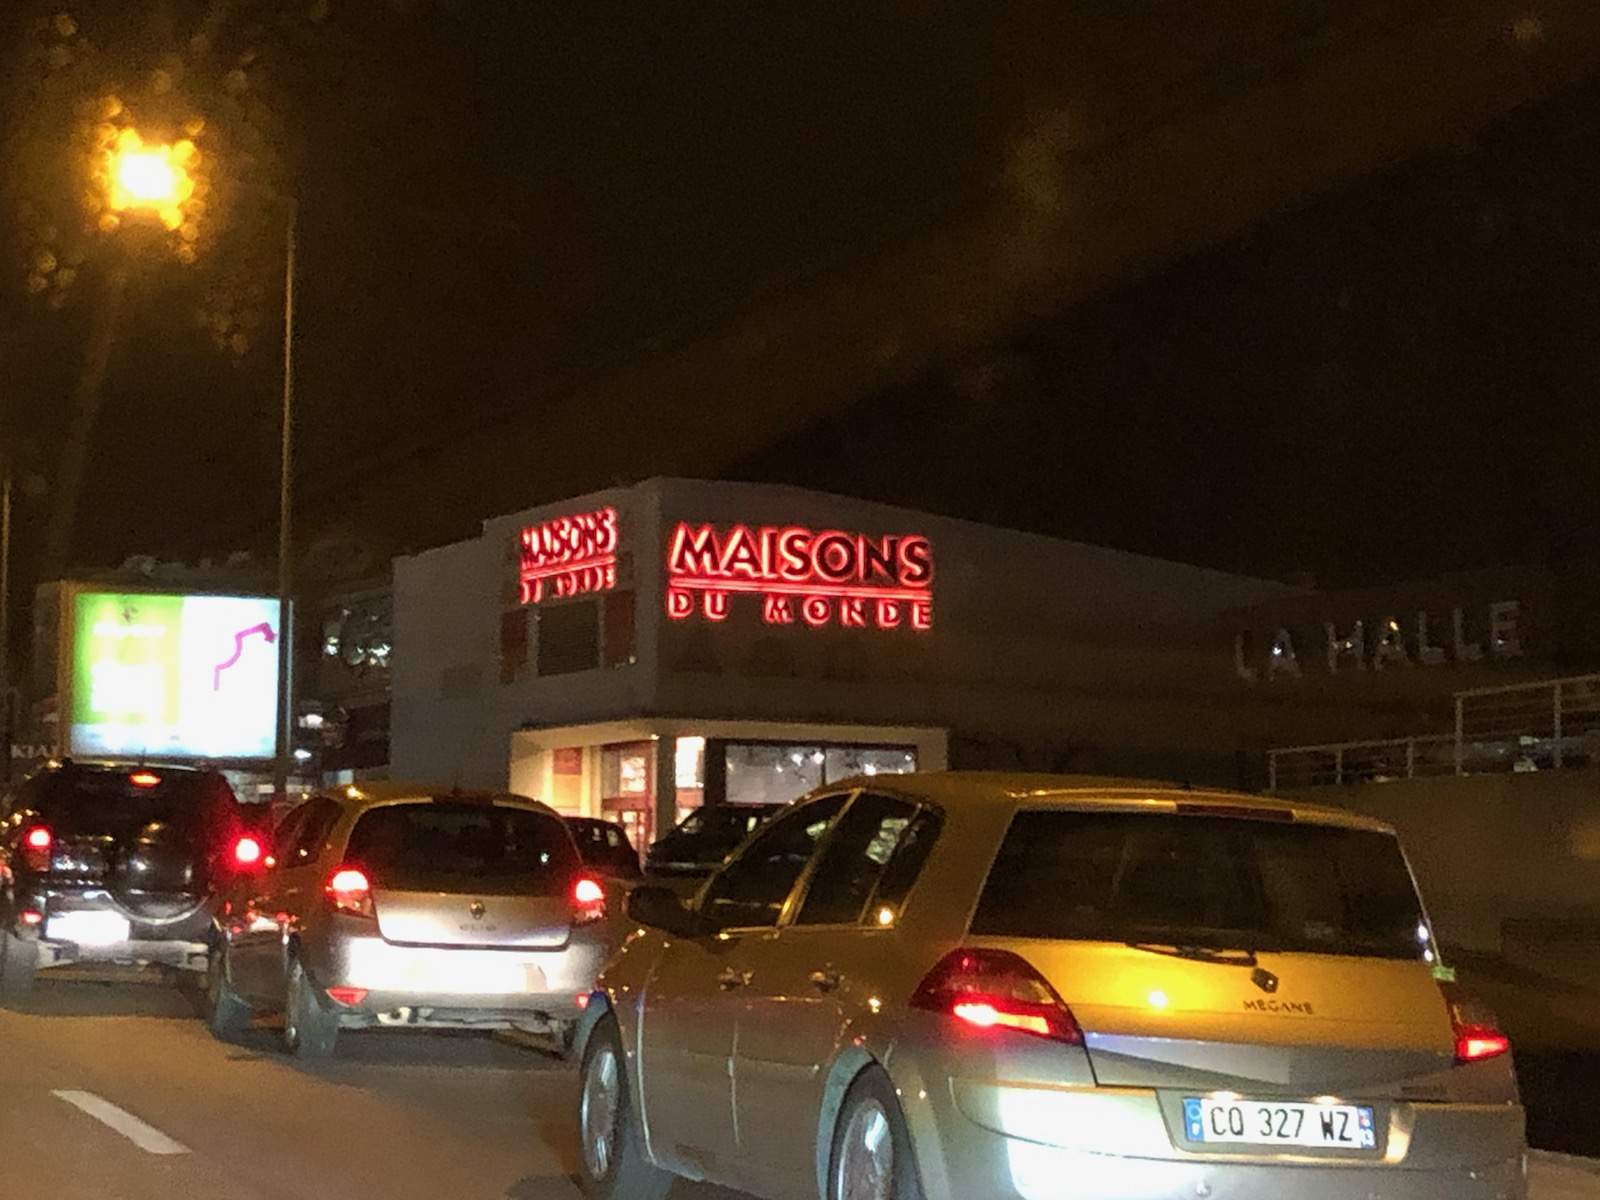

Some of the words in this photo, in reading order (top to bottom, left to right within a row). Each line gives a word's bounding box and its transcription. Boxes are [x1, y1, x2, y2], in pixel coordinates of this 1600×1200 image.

[667, 520, 936, 587] MAISONS
[667, 589, 729, 622] DU
[764, 594, 933, 631] MONDE
[1234, 626, 1304, 682] LA
[1324, 600, 1525, 675] HALLE
[1242, 999, 1314, 1016] MEGANE
[1257, 1108, 1305, 1139] 327
[1319, 1110, 1353, 1142] WZ
